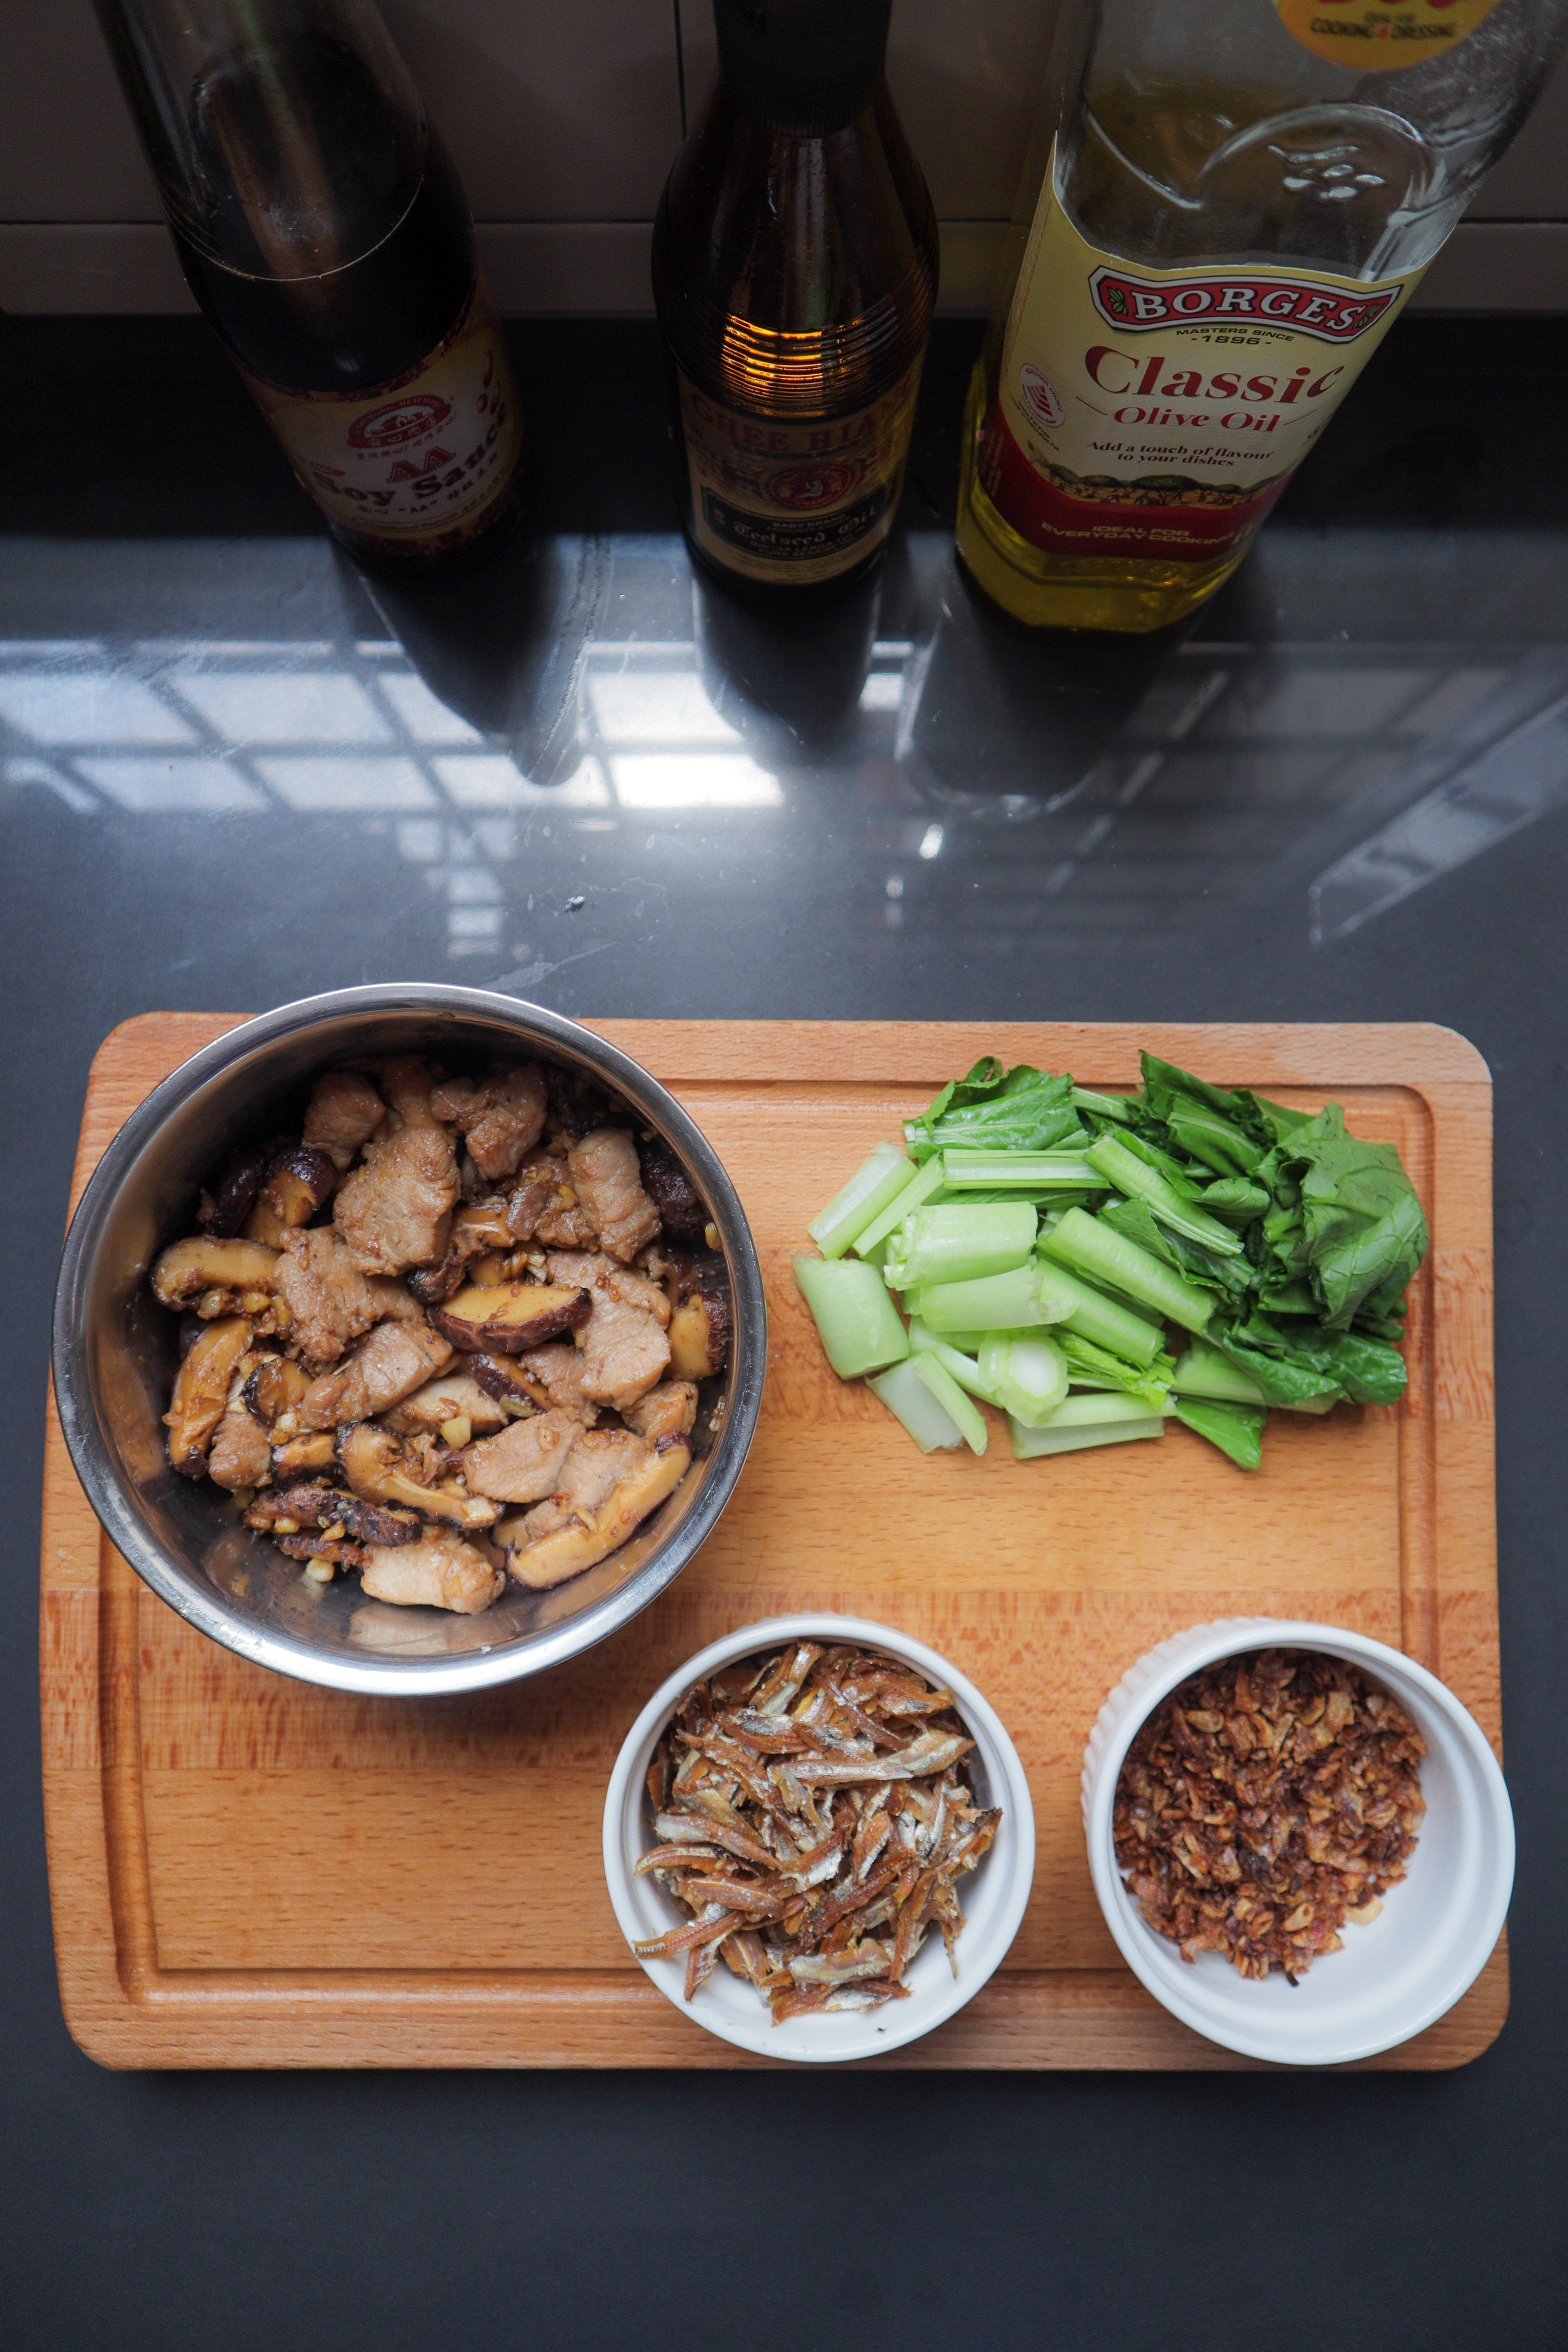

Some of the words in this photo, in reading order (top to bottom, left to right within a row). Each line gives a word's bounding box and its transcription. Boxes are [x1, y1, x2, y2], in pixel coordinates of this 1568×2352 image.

[1132, 287, 1364, 331] BORGES
[1176, 327, 1248, 335] MASTERS
[1252, 329, 1295, 342] SINCE
[1084, 345, 1345, 404] Classic
[1049, 387, 1063, 412] CHOICE
[690, 393, 788, 451] GHEE
[1114, 406, 1210, 427] Olive
[1220, 412, 1281, 432] Oil
[313, 471, 396, 507] Soy
[411, 403, 505, 499] Sauce
[1088, 442, 1121, 452] Add
[1139, 443, 1188, 454] touch
[1193, 445, 1213, 456] of
[1214, 446, 1275, 460] flavour
[1117, 452, 1134, 461] to
[1137, 454, 1180, 464] your
[1182, 454, 1235, 467] dishes
[386, 446, 456, 483] AA
[734, 520, 826, 546] Teelseed
[837, 505, 875, 535] Oil
[806, 513, 846, 527] BRAND
[1042, 521, 1147, 539] EVERYDAY
[1093, 525, 1148, 534] IDEAL
[1151, 528, 1191, 536] FOR
